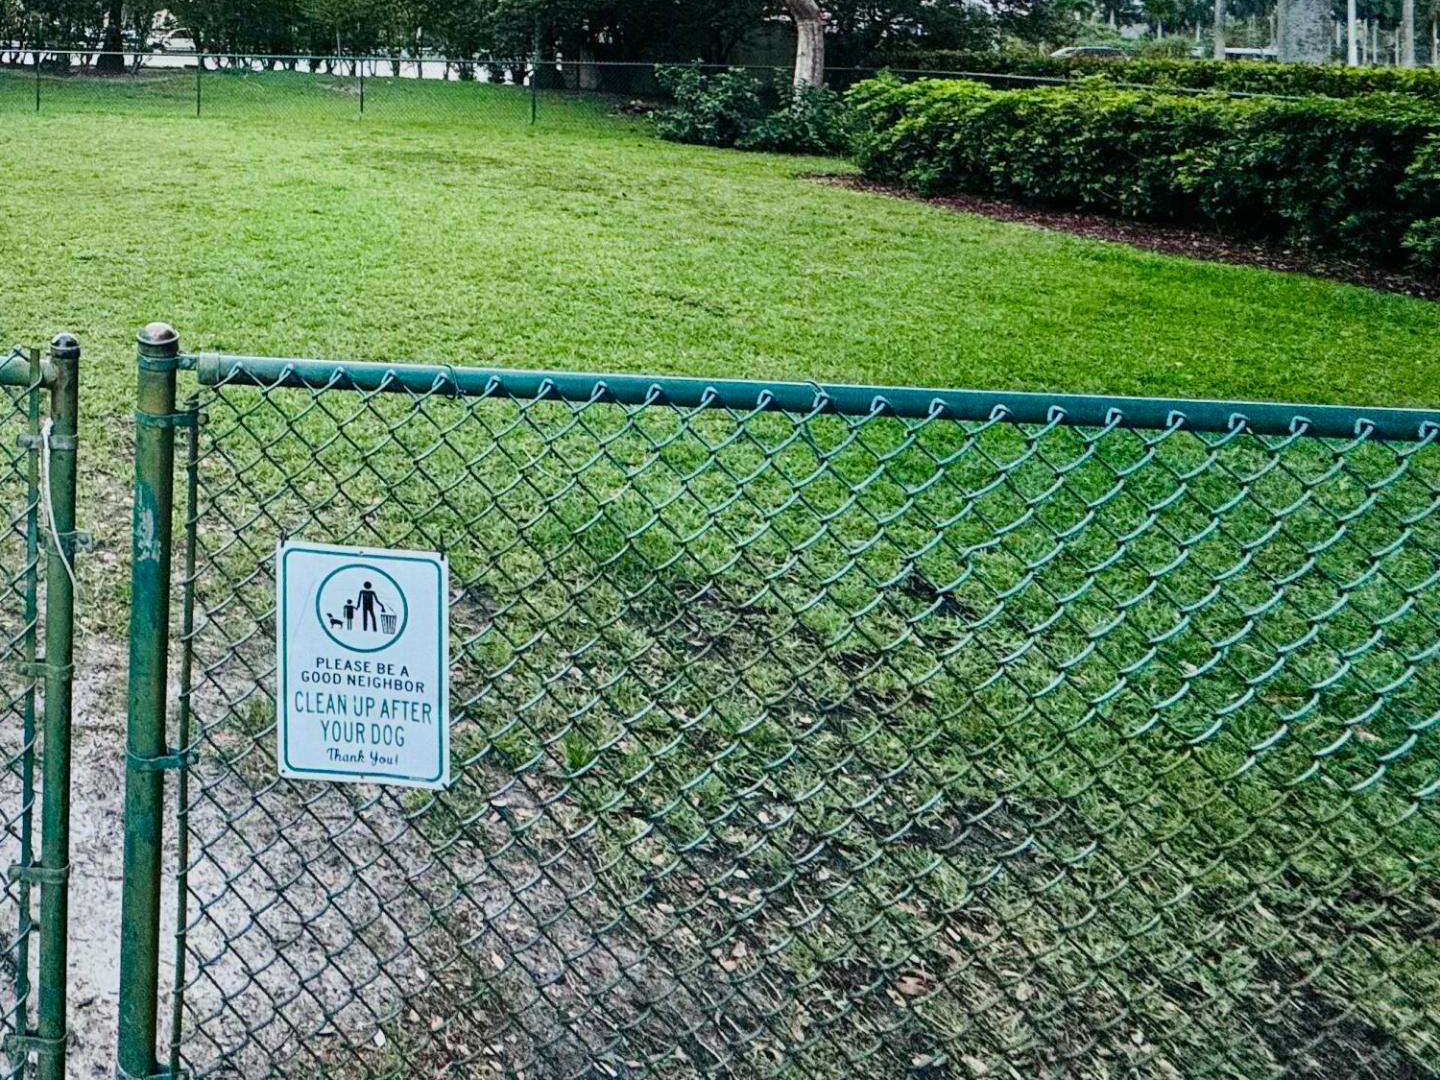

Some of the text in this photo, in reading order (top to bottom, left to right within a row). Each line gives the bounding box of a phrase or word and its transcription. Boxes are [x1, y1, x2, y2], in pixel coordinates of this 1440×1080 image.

[316, 657, 409, 677] PLEASE BE A
[301, 671, 425, 693] GOOD NEIGHBOR
[295, 691, 432, 724] CLEAN UP AFTER
[320, 719, 405, 747] YOUR DOG
[326, 748, 399, 766] Thank You!
